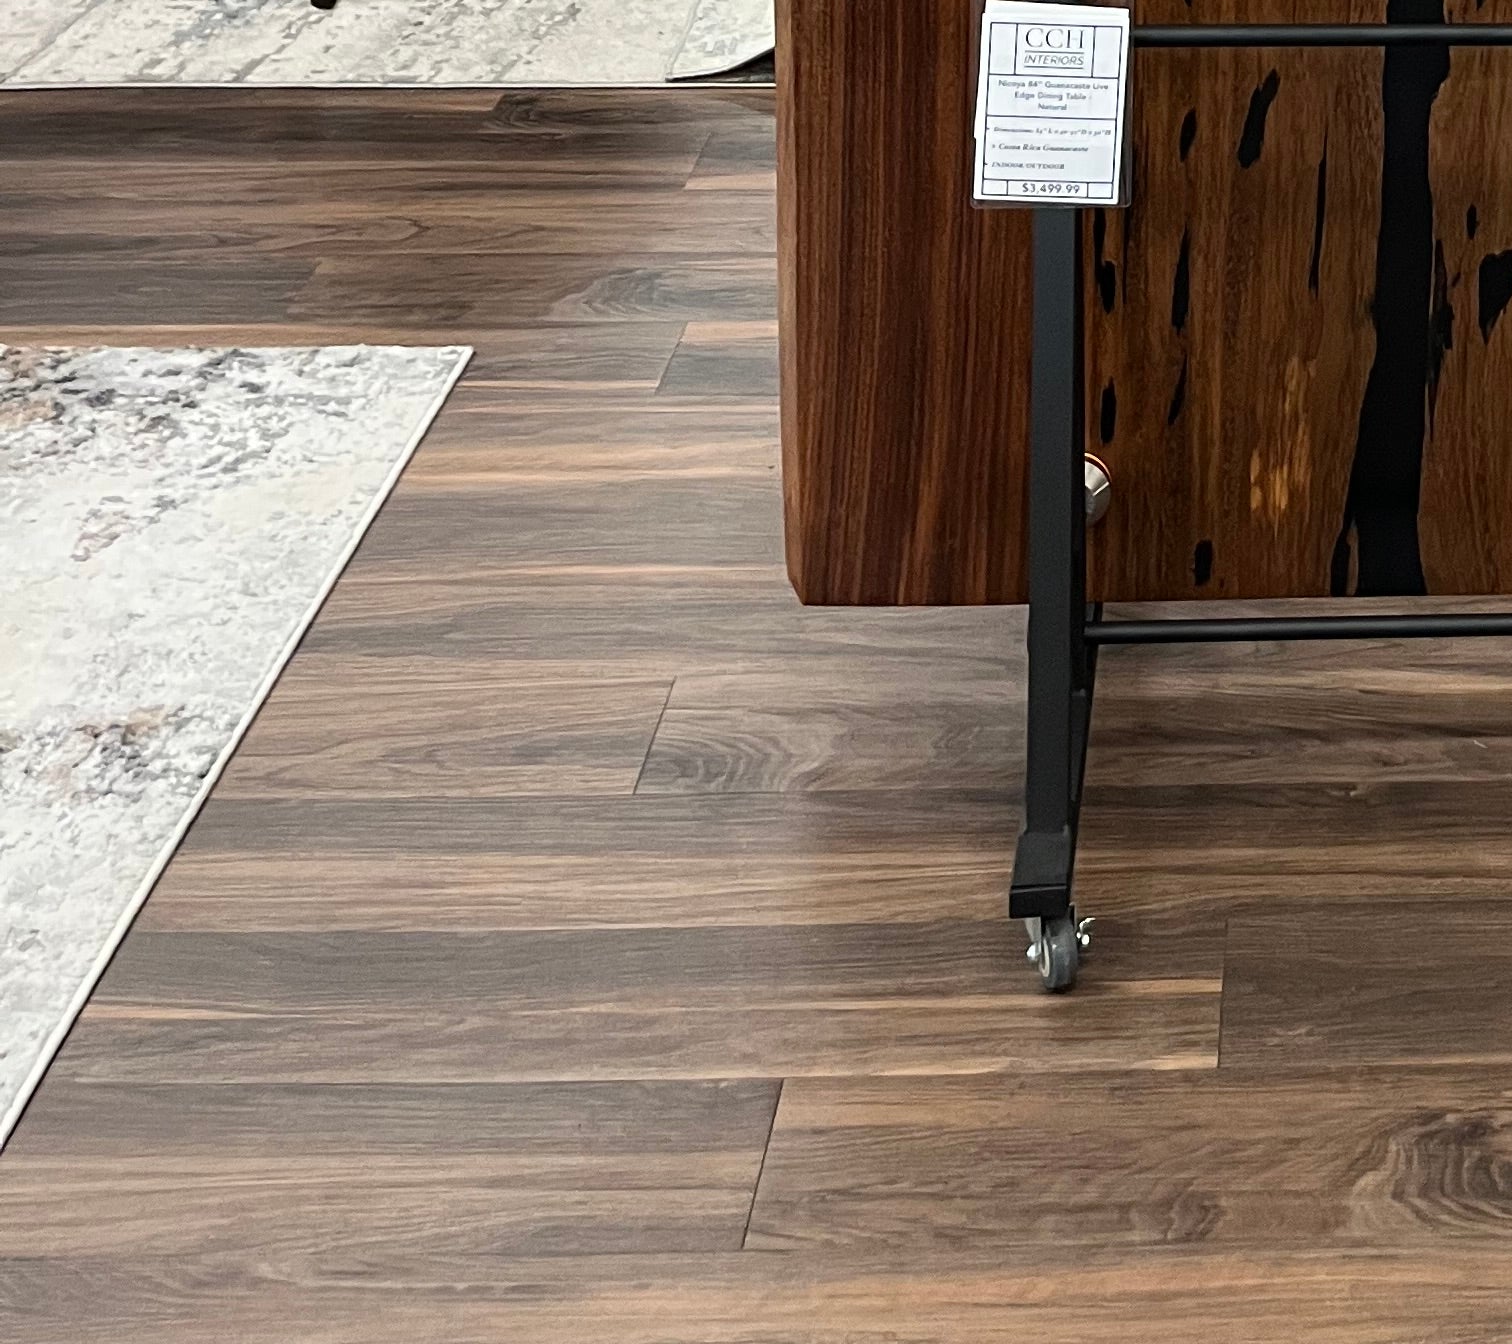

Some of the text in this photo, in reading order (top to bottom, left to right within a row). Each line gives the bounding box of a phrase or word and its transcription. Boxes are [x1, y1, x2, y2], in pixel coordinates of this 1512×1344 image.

[1025, 27, 1085, 49] CCH
[1024, 54, 1085, 66] INTERIORS
[1014, 91, 1035, 101] Edge
[1022, 182, 1080, 195] $3,499.99
